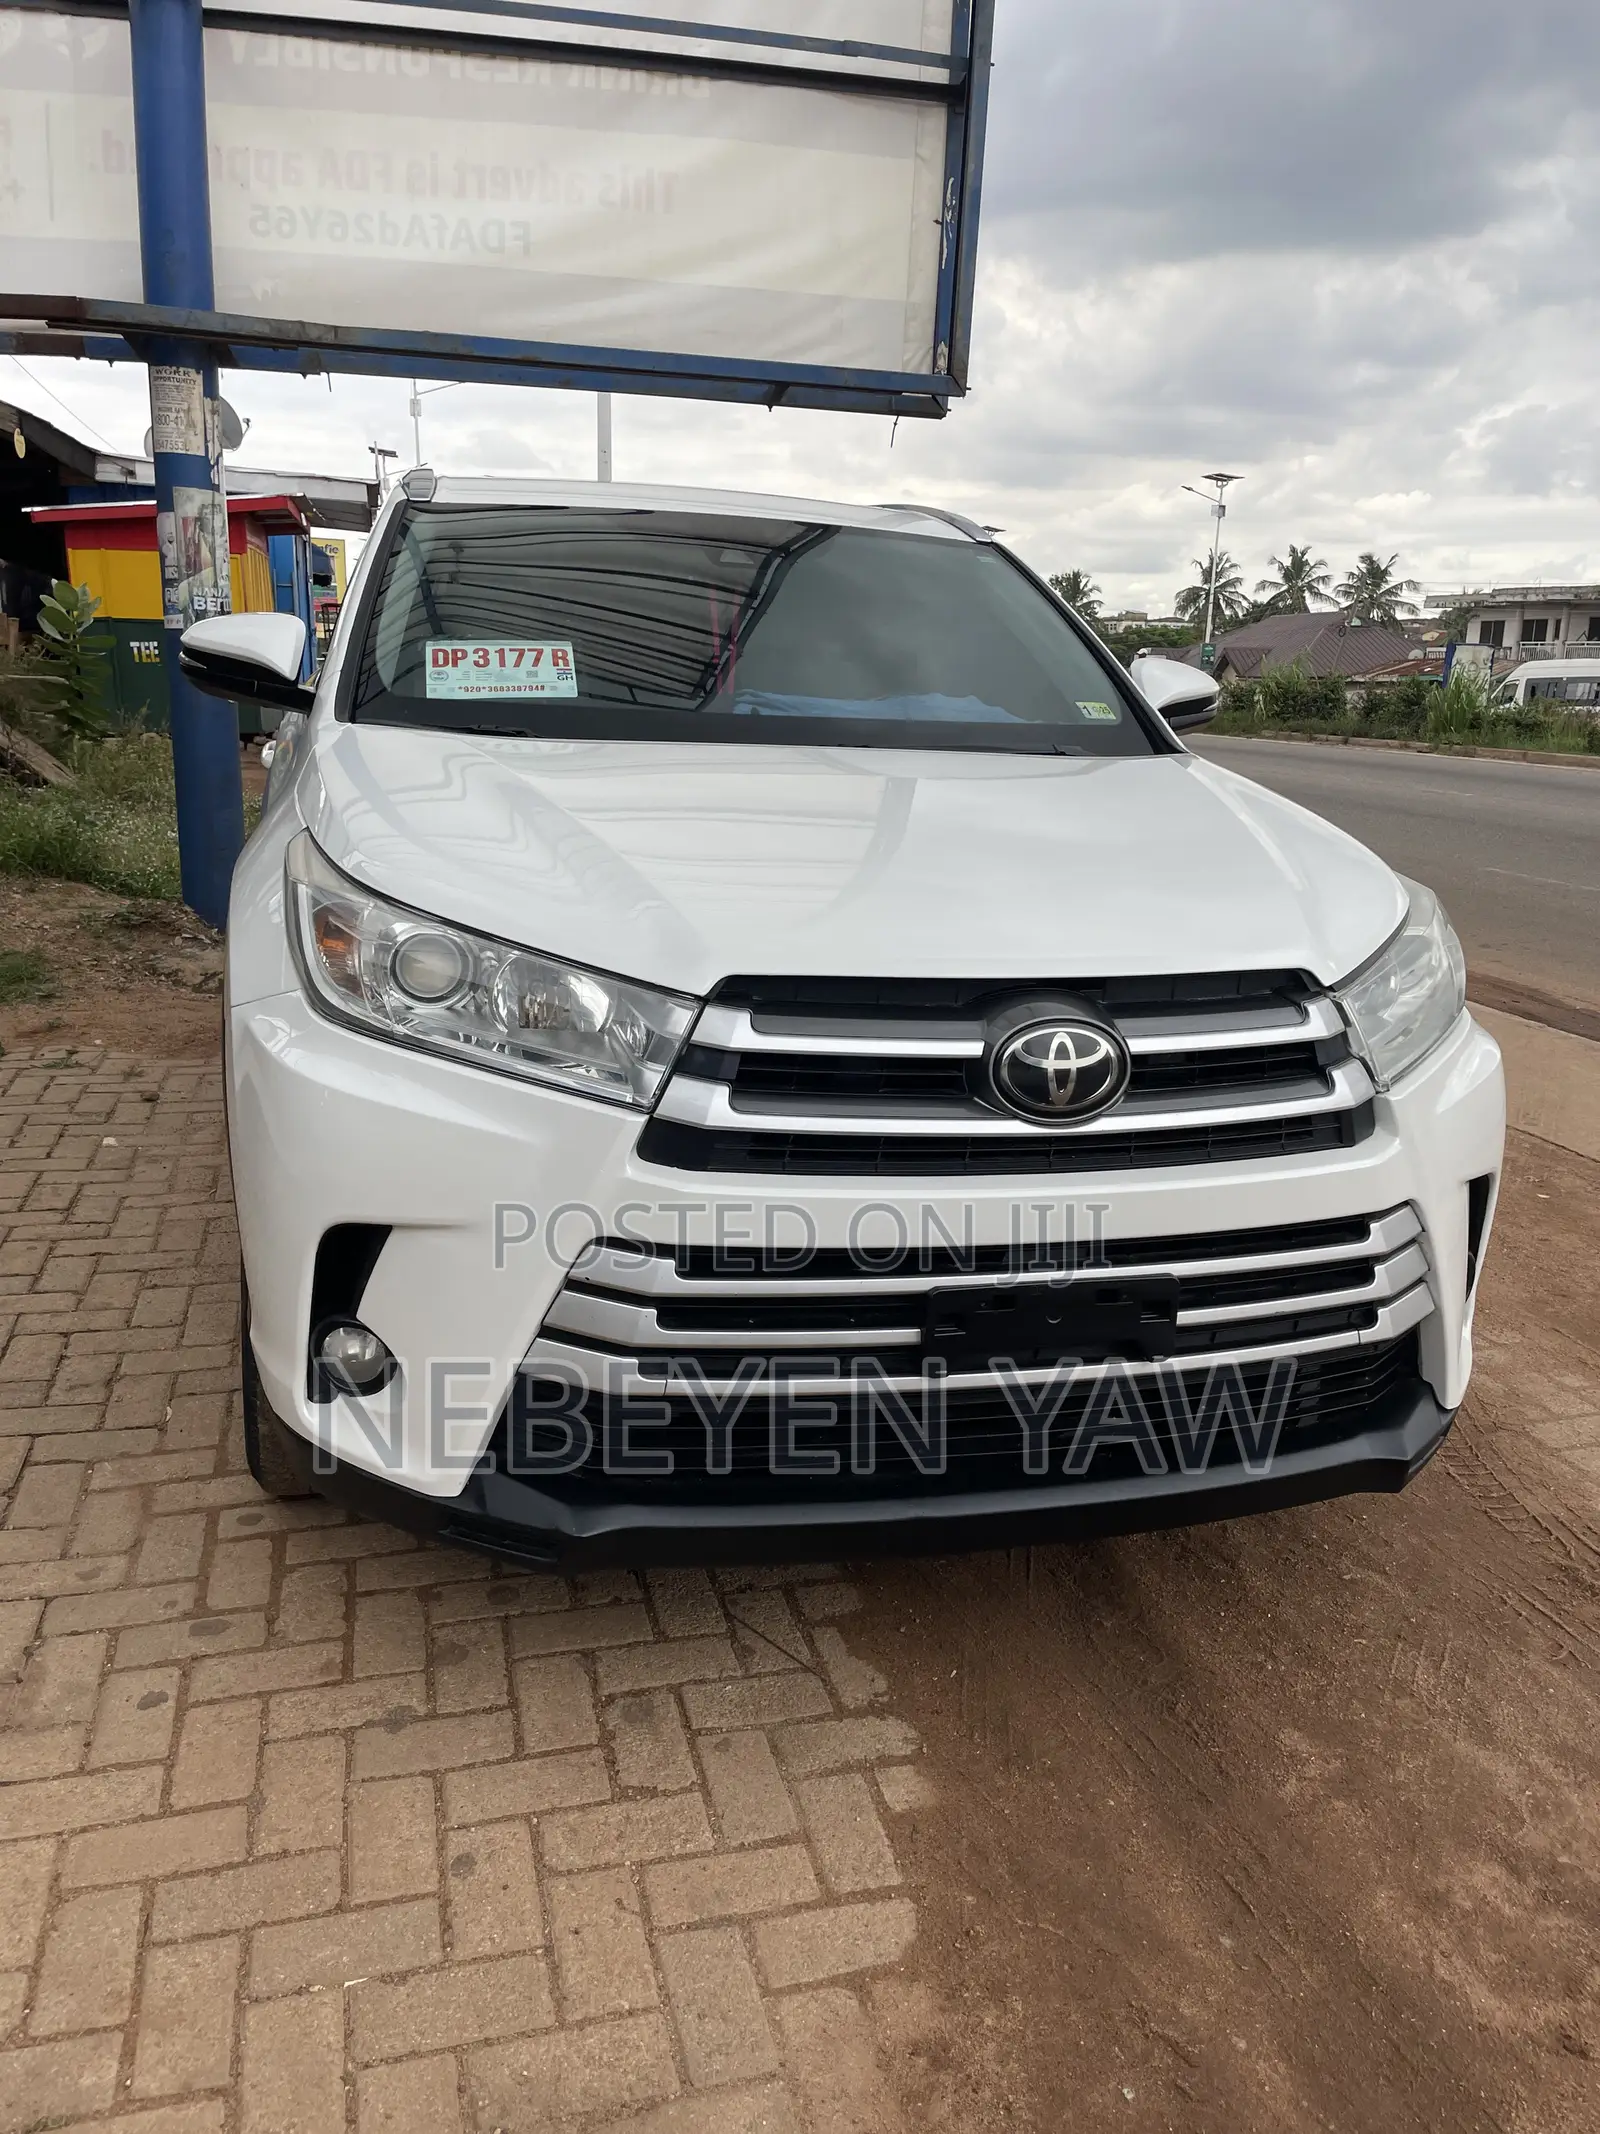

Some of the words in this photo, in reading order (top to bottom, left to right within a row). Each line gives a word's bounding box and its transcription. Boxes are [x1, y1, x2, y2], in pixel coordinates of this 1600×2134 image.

[155, 367, 192, 378] WORK
[130, 641, 160, 663] TEE
[431, 648, 468, 668] DP
[472, 648, 544, 668] 3177
[551, 648, 570, 667] R
